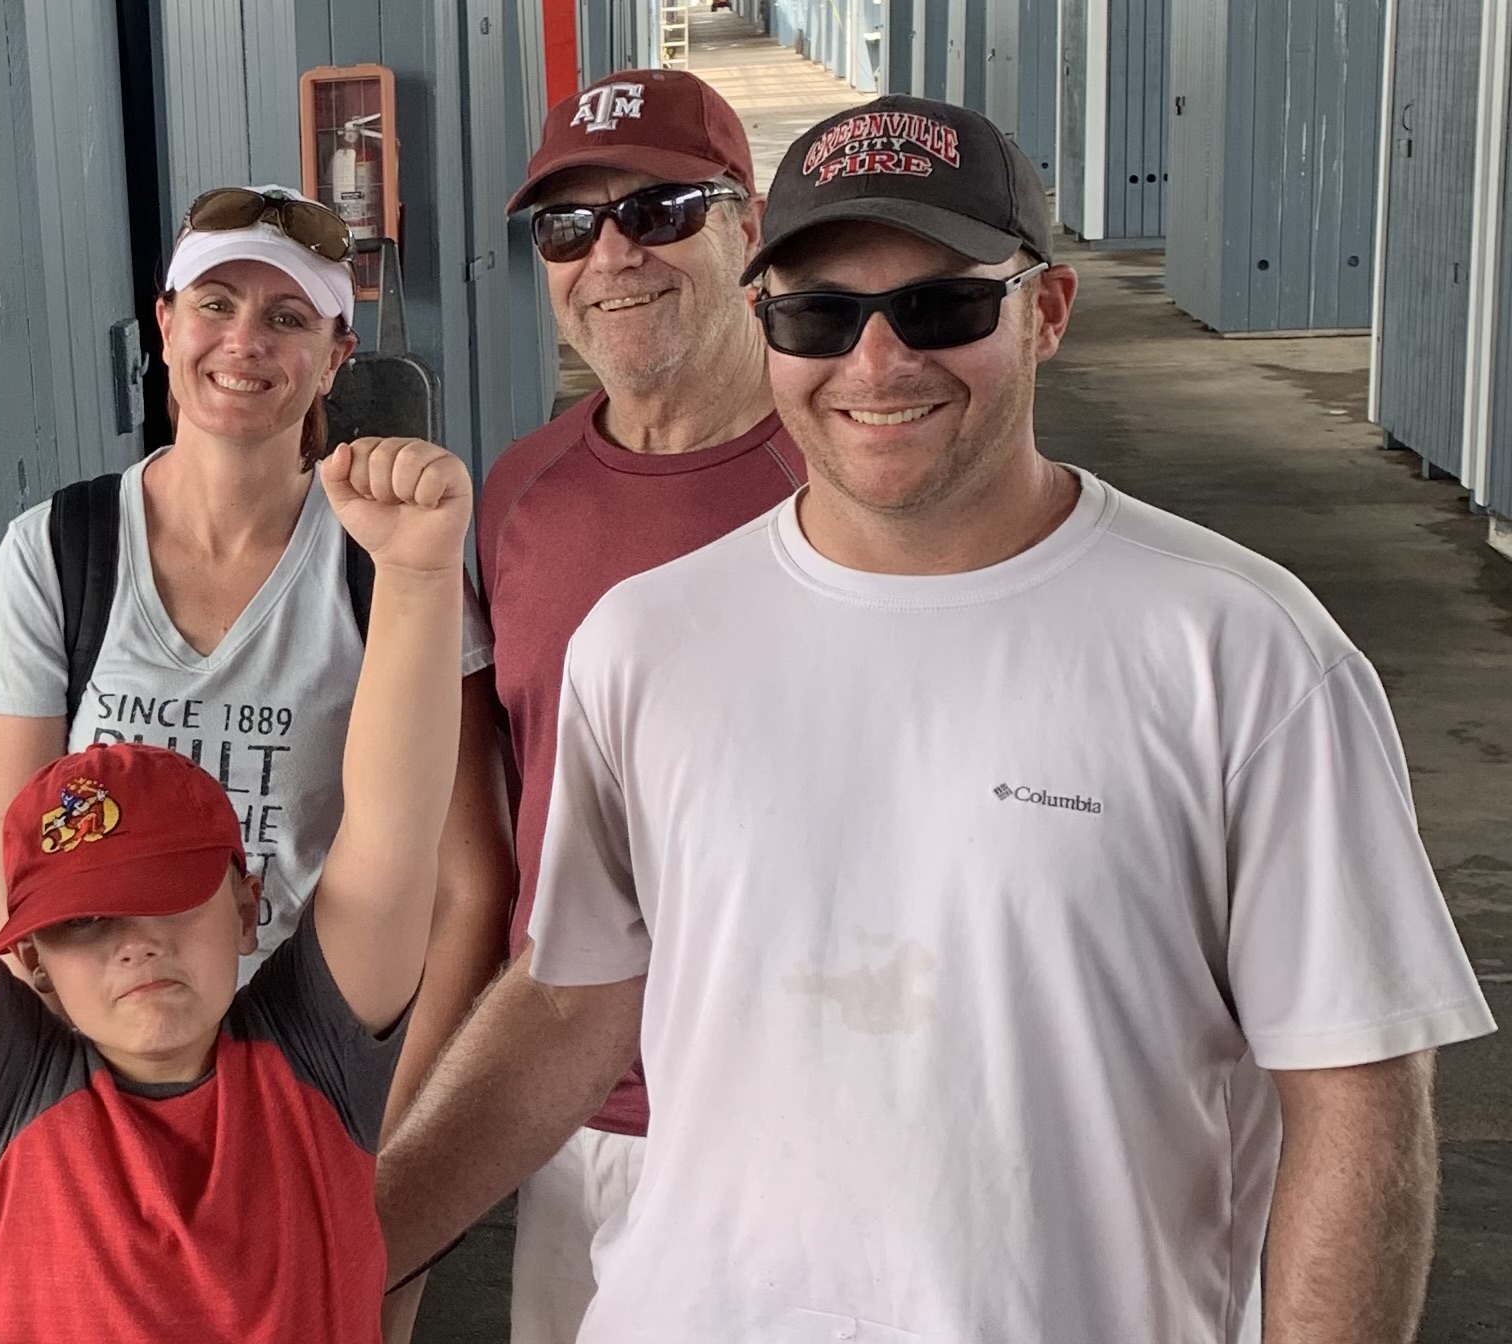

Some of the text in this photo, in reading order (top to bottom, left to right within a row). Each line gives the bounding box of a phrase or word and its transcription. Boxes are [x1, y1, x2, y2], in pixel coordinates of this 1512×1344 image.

[802, 112, 960, 175] GREENVILLE
[845, 137, 907, 155] CITY
[815, 150, 932, 187] FIRE
[98, 694, 293, 737] SINCE 1889
[1014, 786, 1102, 814] Columbia
